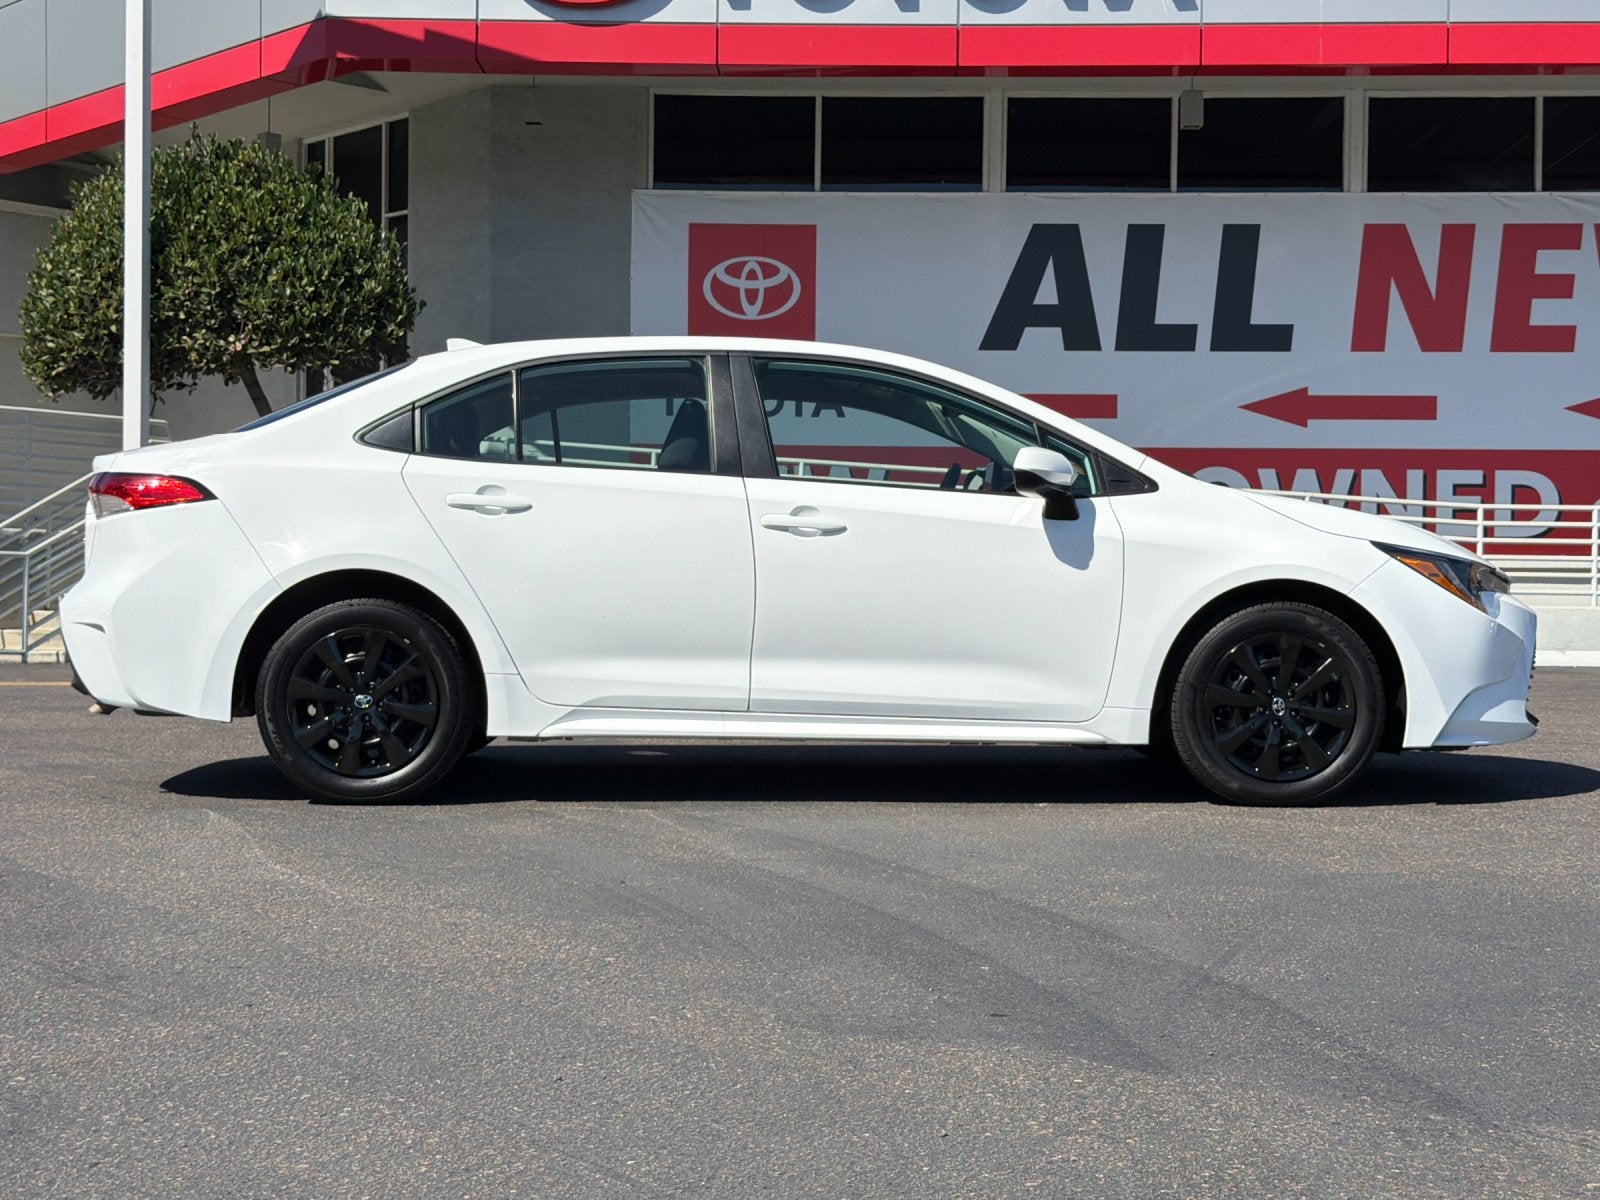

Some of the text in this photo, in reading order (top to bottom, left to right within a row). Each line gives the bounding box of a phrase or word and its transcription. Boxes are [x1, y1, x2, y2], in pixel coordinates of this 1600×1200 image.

[979, 223, 1600, 353] ALL NE
[1193, 466, 1562, 538] NED
